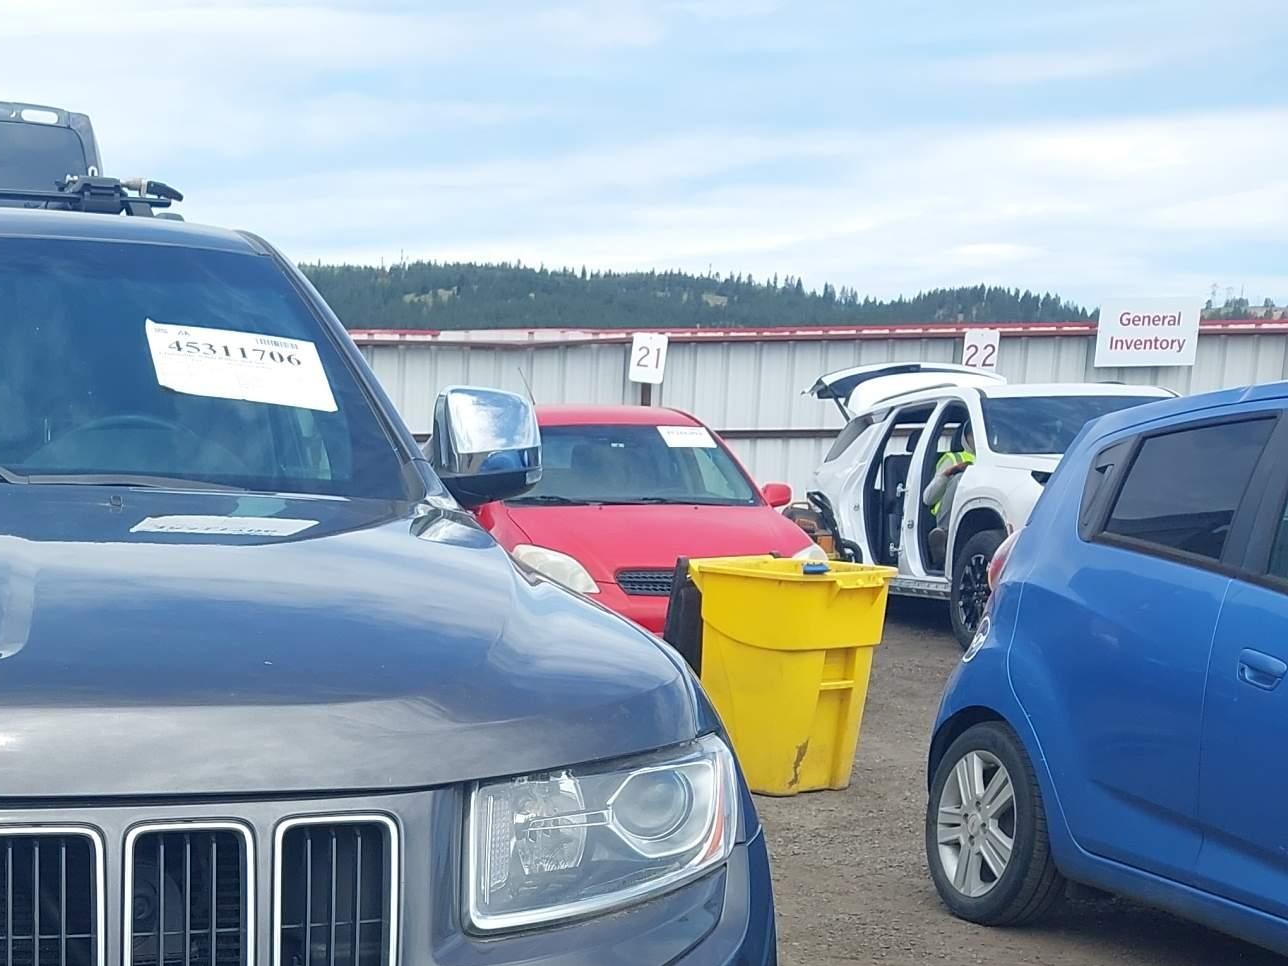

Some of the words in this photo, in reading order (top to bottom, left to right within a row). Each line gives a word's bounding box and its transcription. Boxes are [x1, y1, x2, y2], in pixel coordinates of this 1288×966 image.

[1119, 311, 1182, 326] General
[167, 339, 302, 367] 45311706
[964, 343, 996, 368] 22
[1109, 335, 1186, 353] Inventory
[636, 345, 662, 370] 21
